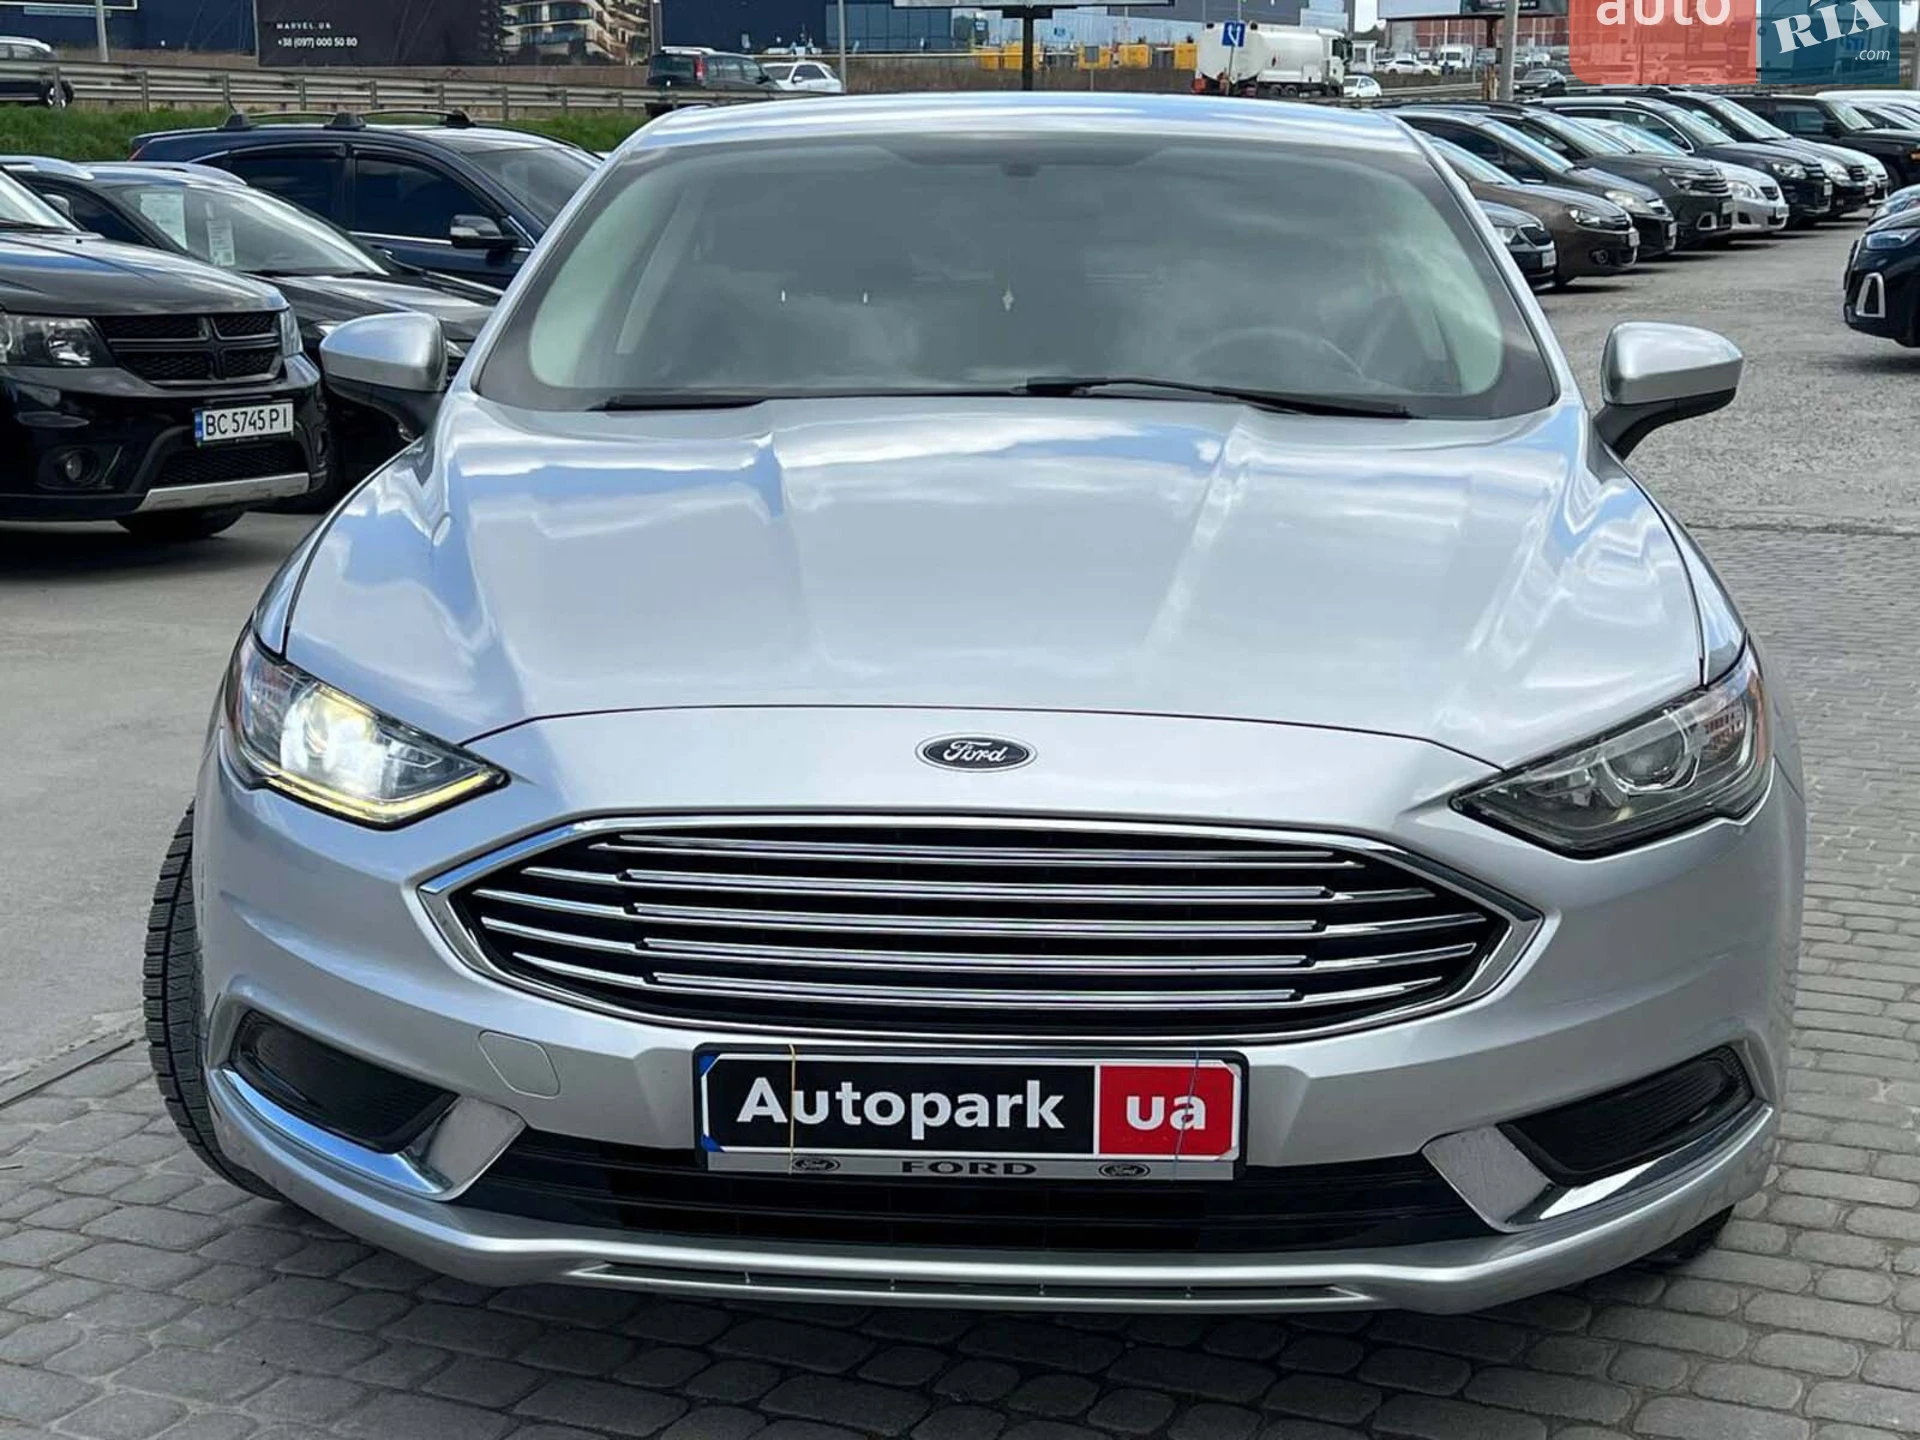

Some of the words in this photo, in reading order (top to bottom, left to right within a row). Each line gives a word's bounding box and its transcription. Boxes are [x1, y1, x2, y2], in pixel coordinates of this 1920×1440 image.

[316, 37, 333, 47] 000
[205, 413, 228, 436] BC
[231, 409, 266, 433] 5745
[943, 740, 1008, 762] Ford
[736, 1076, 1066, 1140] Autopark
[1126, 1095, 1207, 1131] ua
[902, 1161, 1037, 1175] FORD
